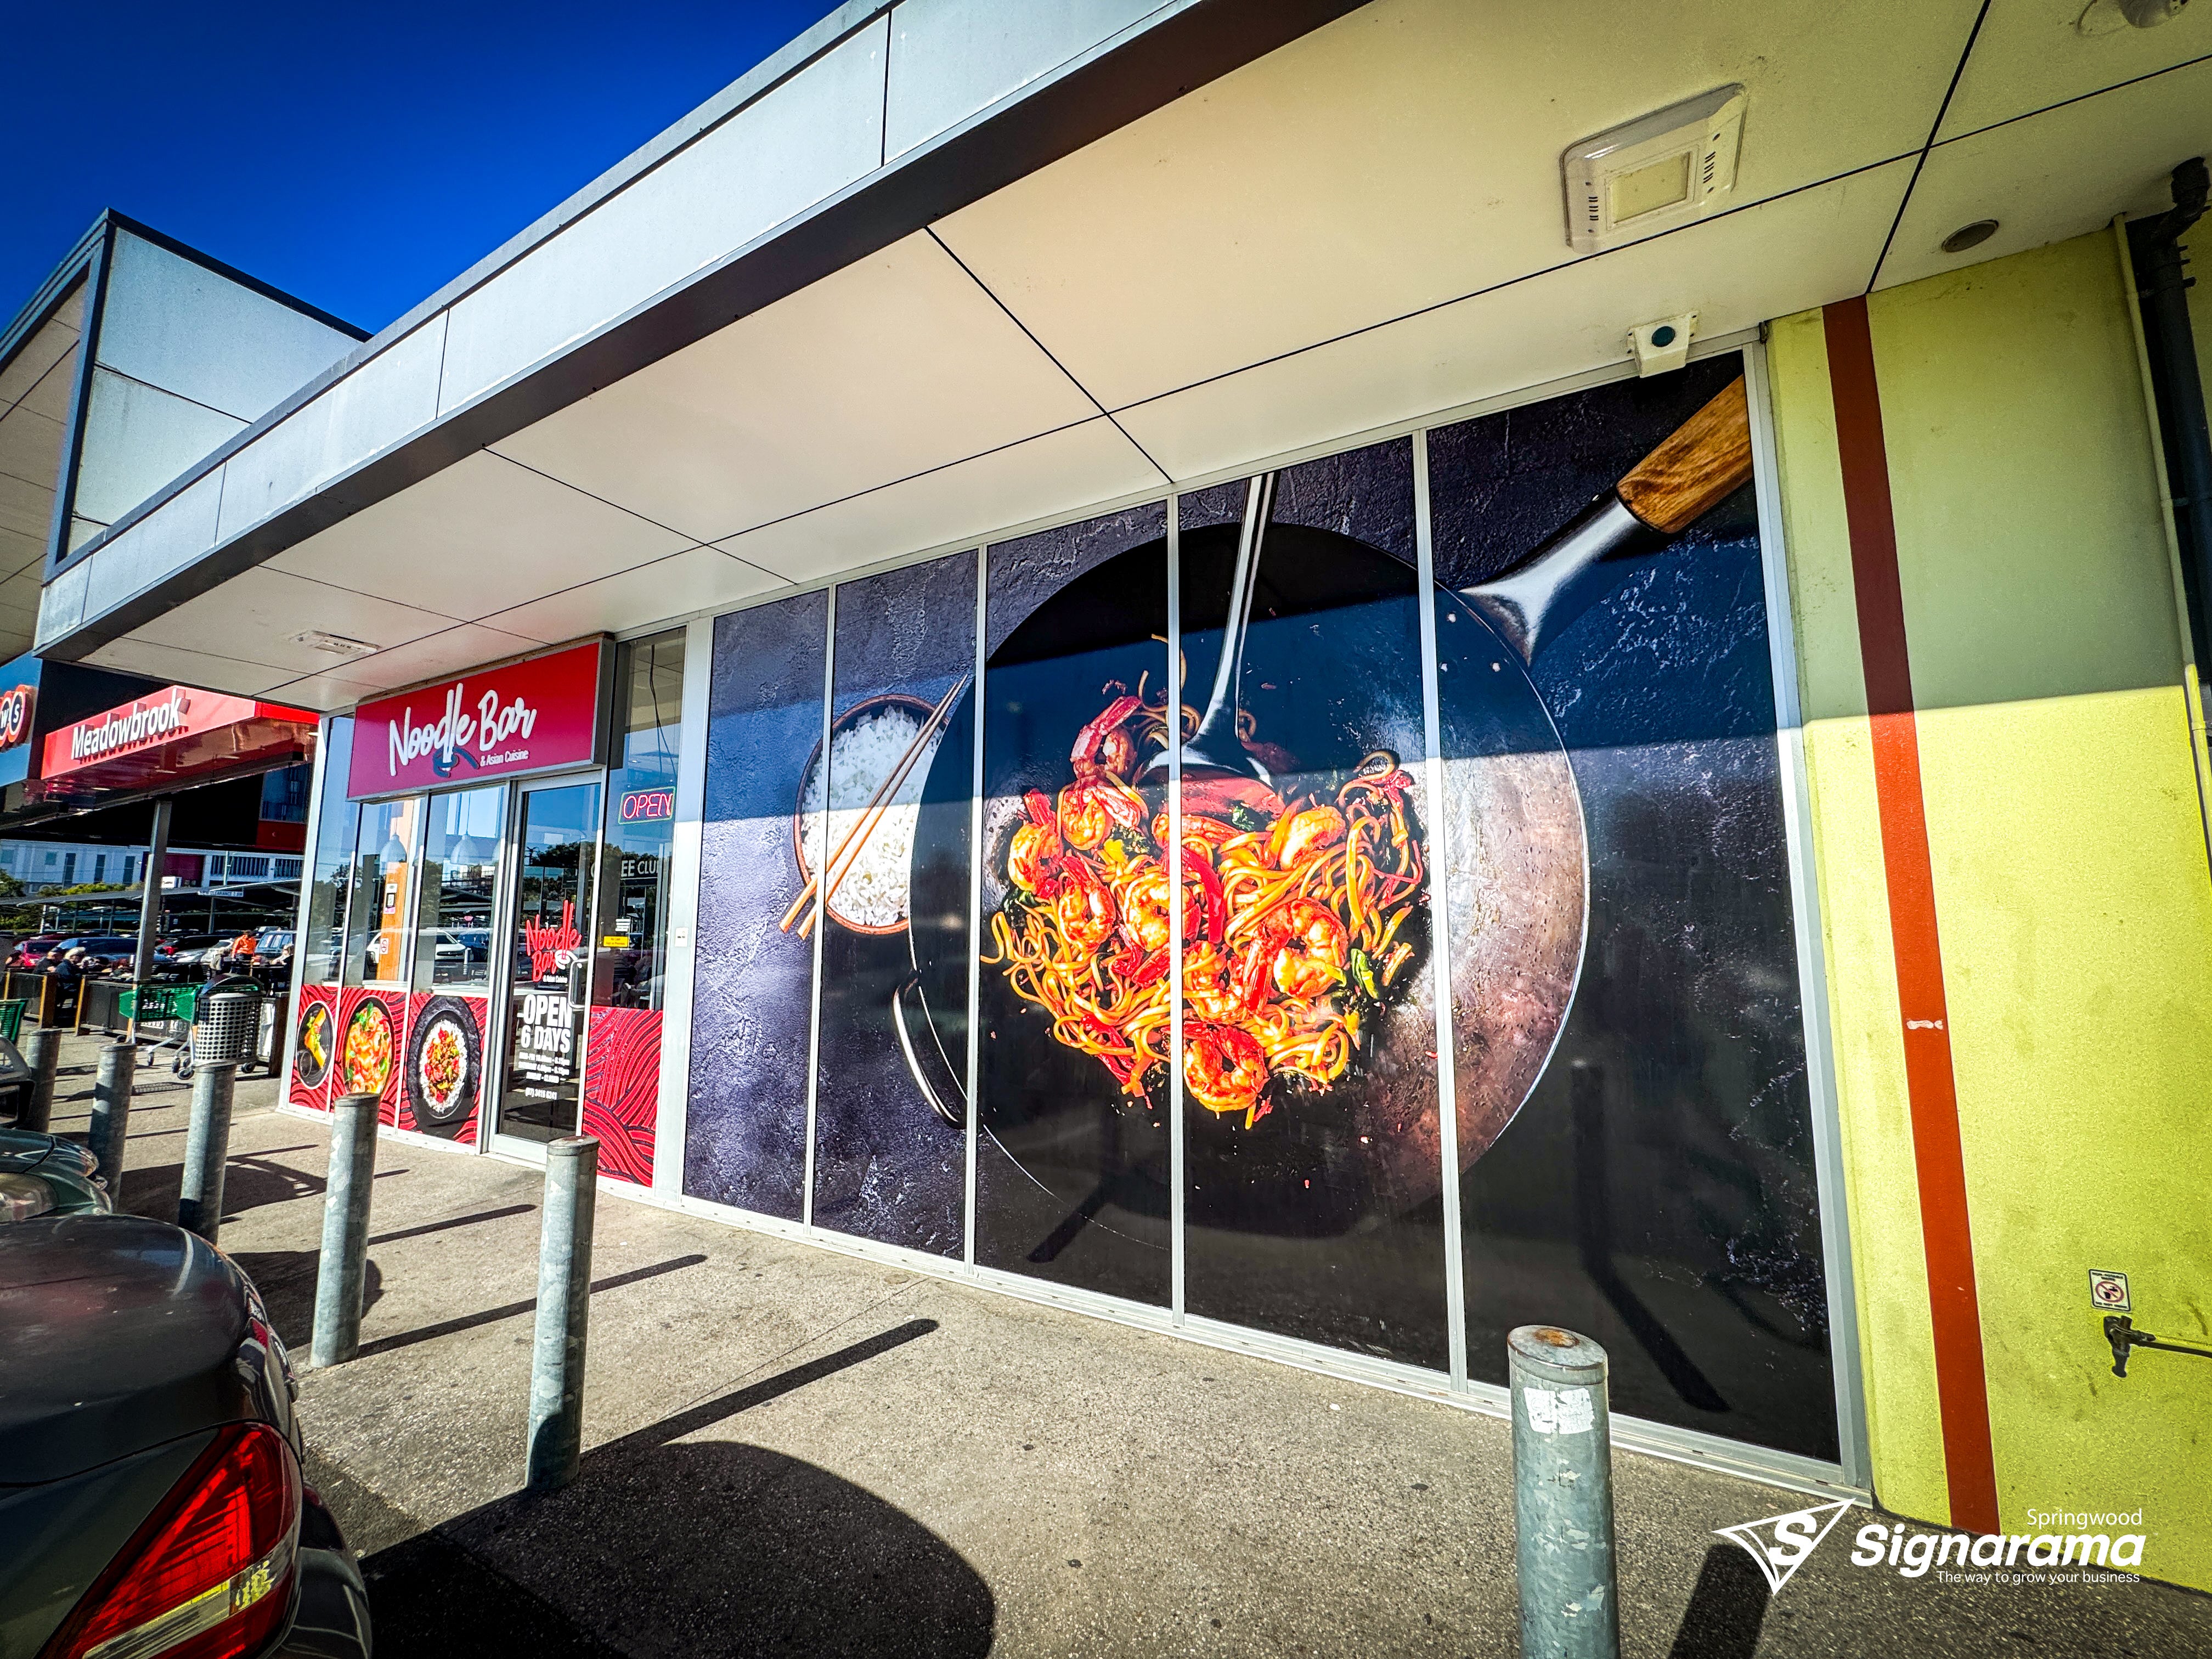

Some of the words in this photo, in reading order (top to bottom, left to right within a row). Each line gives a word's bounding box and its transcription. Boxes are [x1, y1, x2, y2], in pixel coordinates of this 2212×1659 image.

[71, 687, 182, 760] Meadowbrook
[390, 682, 477, 776] Noodle
[478, 690, 537, 752] Bar
[479, 755, 486, 767] &
[486, 753, 504, 766] Asian
[505, 748, 529, 763] Cuisine
[623, 793, 674, 819] OPEN
[637, 860, 659, 876] CLU
[525, 899, 583, 956] Noodle
[531, 950, 557, 982] Bar
[523, 994, 572, 1028] OPEN
[521, 1025, 531, 1048] 6
[534, 1025, 571, 1053] DAYS
